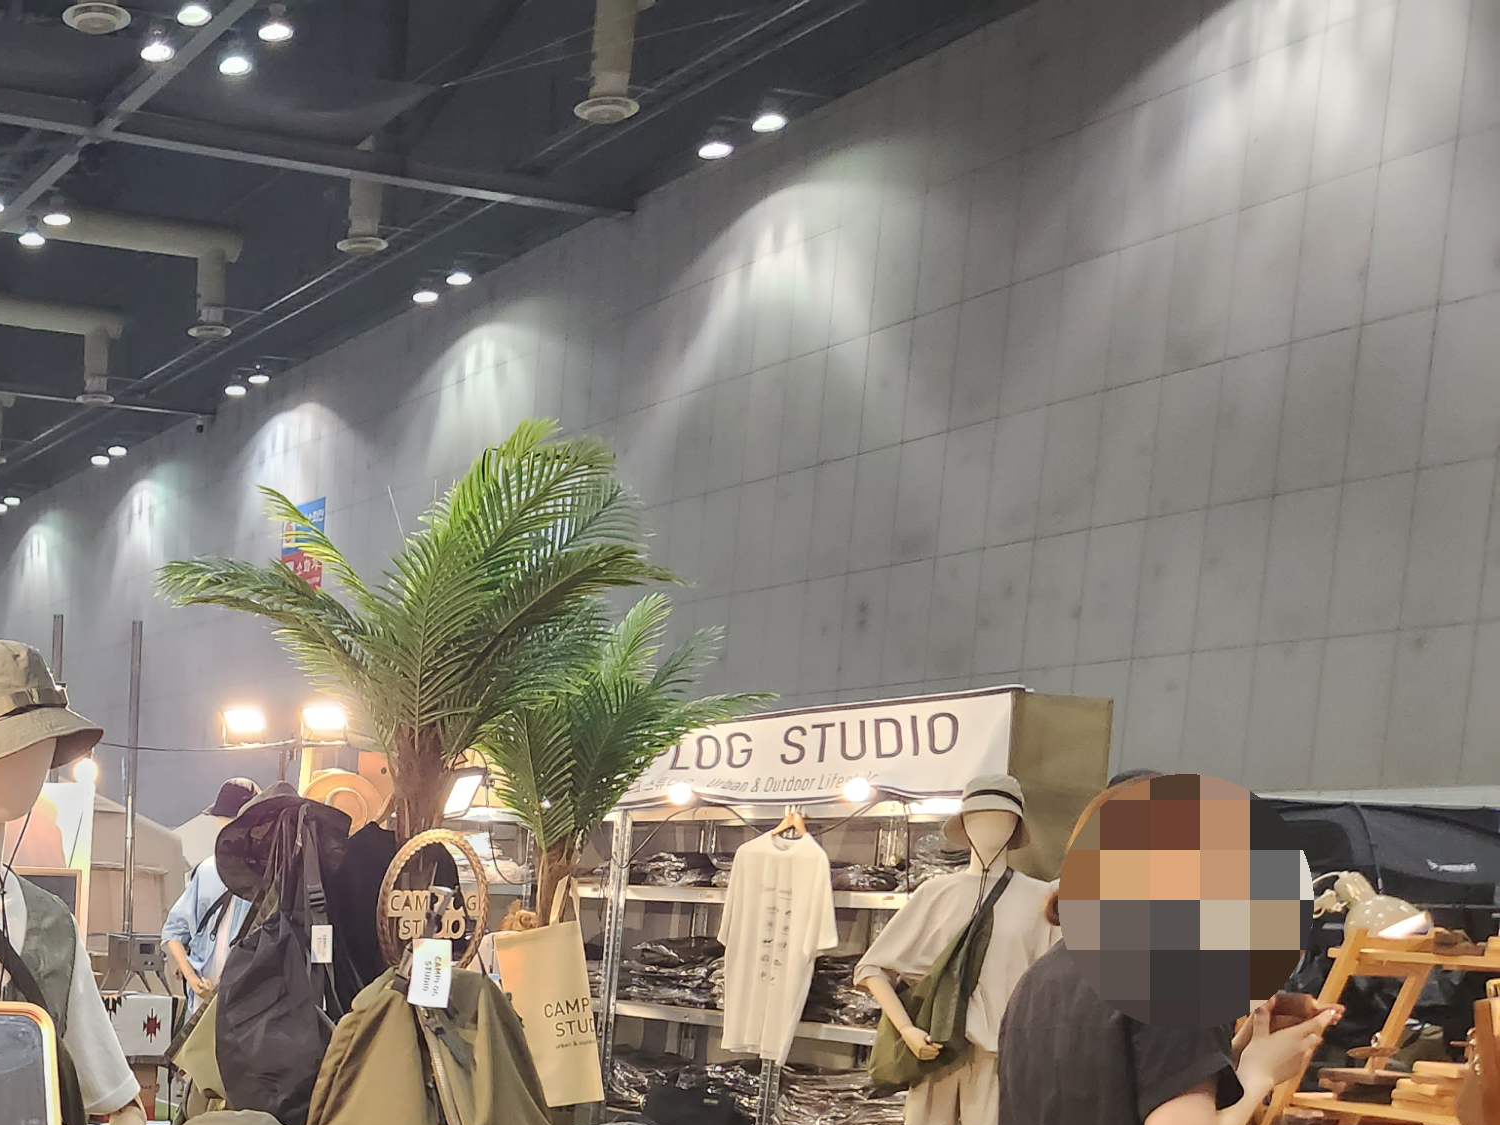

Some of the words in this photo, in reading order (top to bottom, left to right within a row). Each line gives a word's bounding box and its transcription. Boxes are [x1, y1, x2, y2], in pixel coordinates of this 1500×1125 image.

[779, 712, 960, 766] STUDIO
[763, 775, 816, 793] Outdoor
[544, 997, 590, 1018] CAMP
